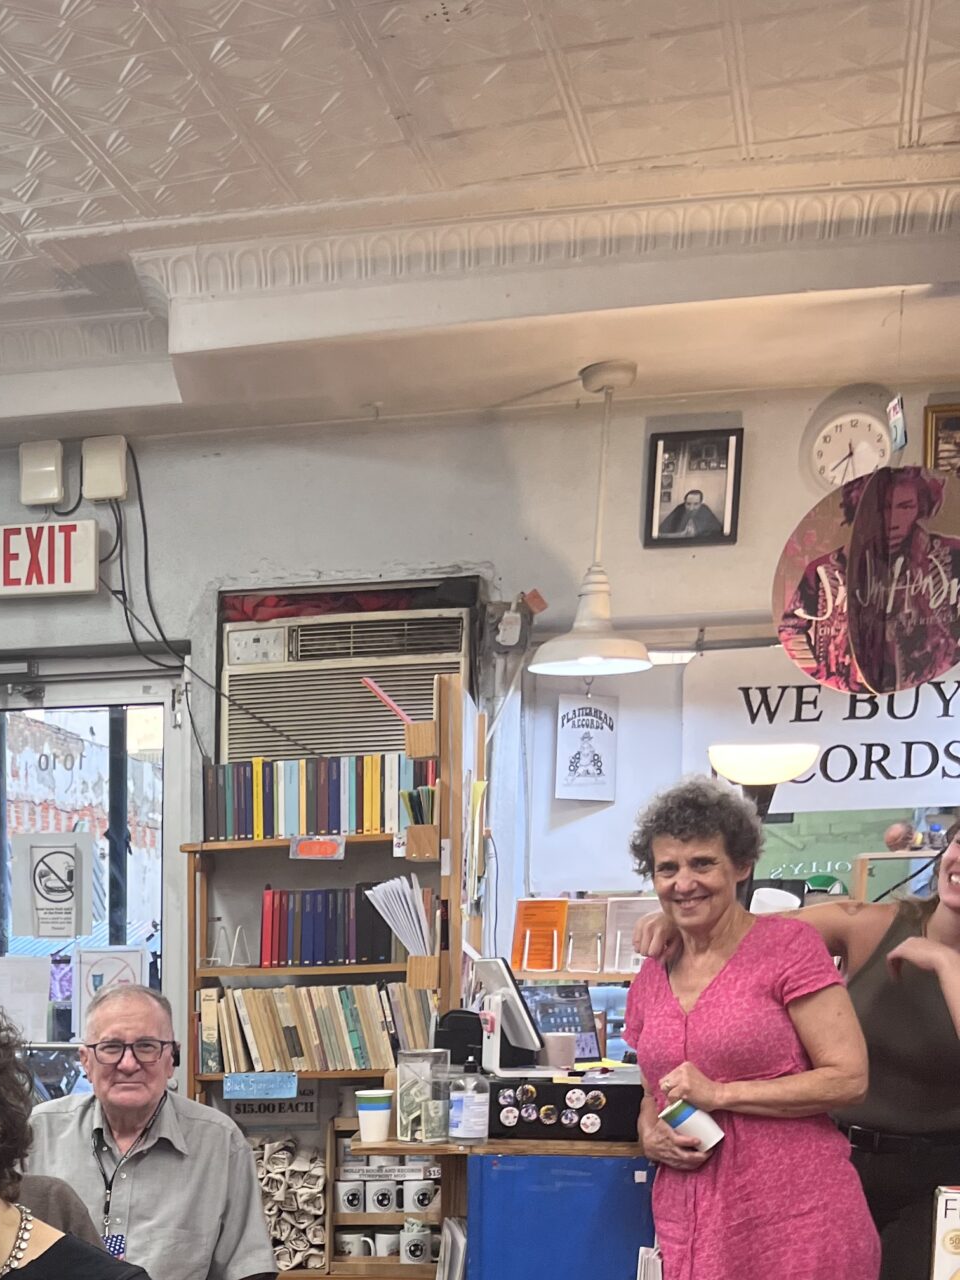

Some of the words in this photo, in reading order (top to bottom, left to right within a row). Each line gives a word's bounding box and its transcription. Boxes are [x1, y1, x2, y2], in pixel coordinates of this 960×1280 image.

[3, 524, 77, 587] EXIT
[738, 684, 823, 725] WE
[842, 680, 959, 720] BUY
[571, 718, 604, 731] RECORDS
[235, 1103, 276, 1115] $15.00
[278, 1102, 314, 1113] EACH
[427, 1169, 441, 1177] $15
